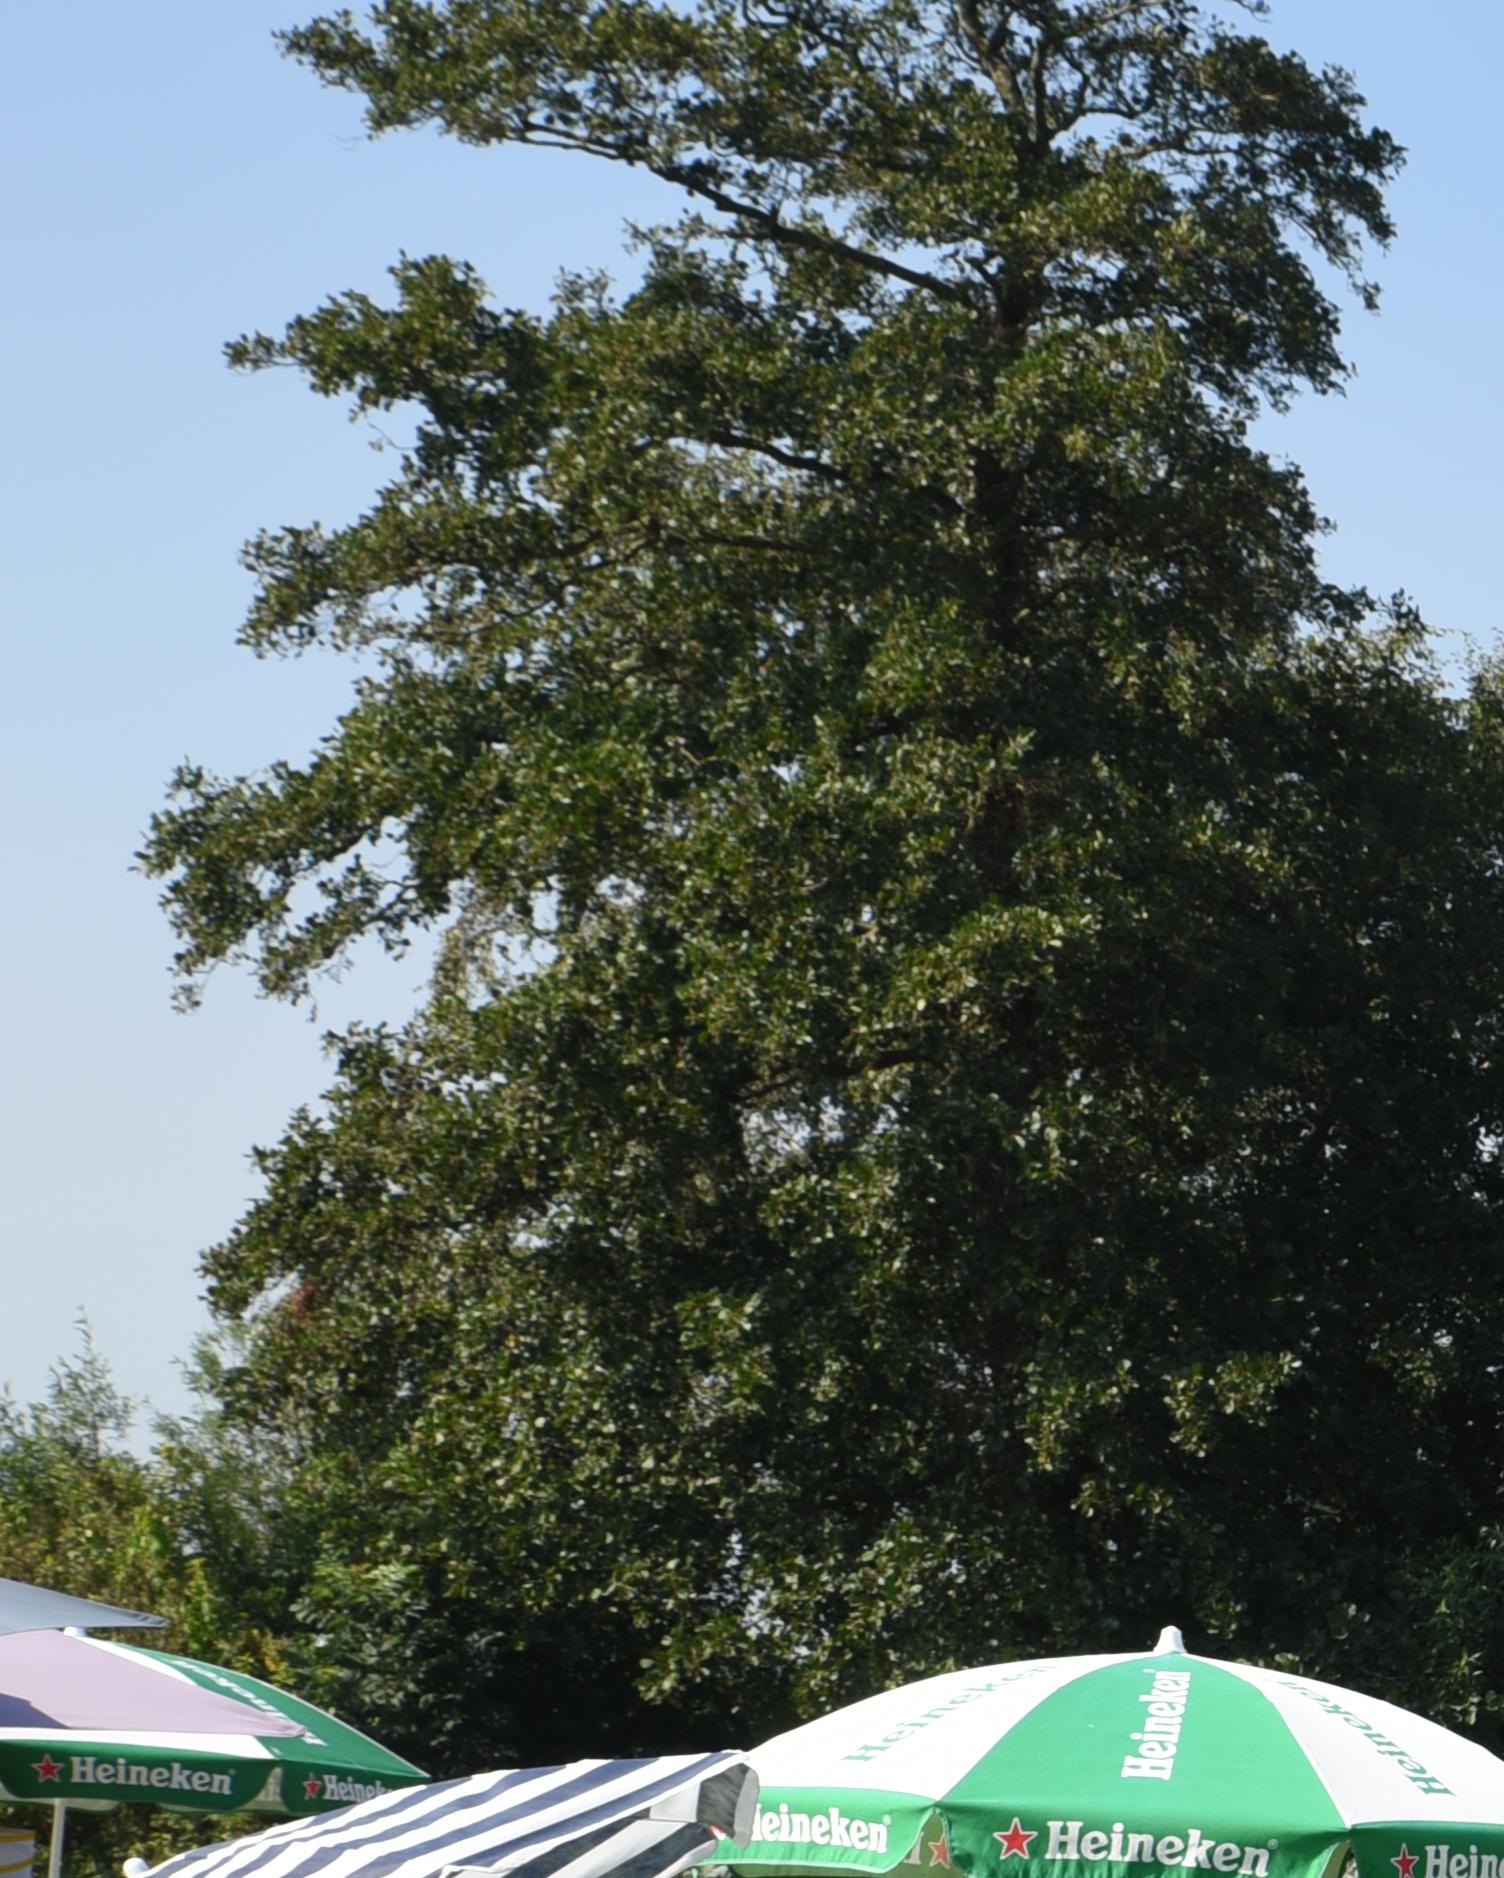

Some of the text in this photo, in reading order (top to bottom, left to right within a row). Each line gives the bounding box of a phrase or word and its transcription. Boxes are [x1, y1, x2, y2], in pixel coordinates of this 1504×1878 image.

[1120, 1669, 1192, 1782] Heineken
[1276, 1680, 1457, 1797] Heineken
[69, 1755, 234, 1795] Heineken
[324, 1773, 394, 1801] Heinek
[751, 1802, 889, 1854] eineken
[1044, 1820, 1271, 1878] Heineken
